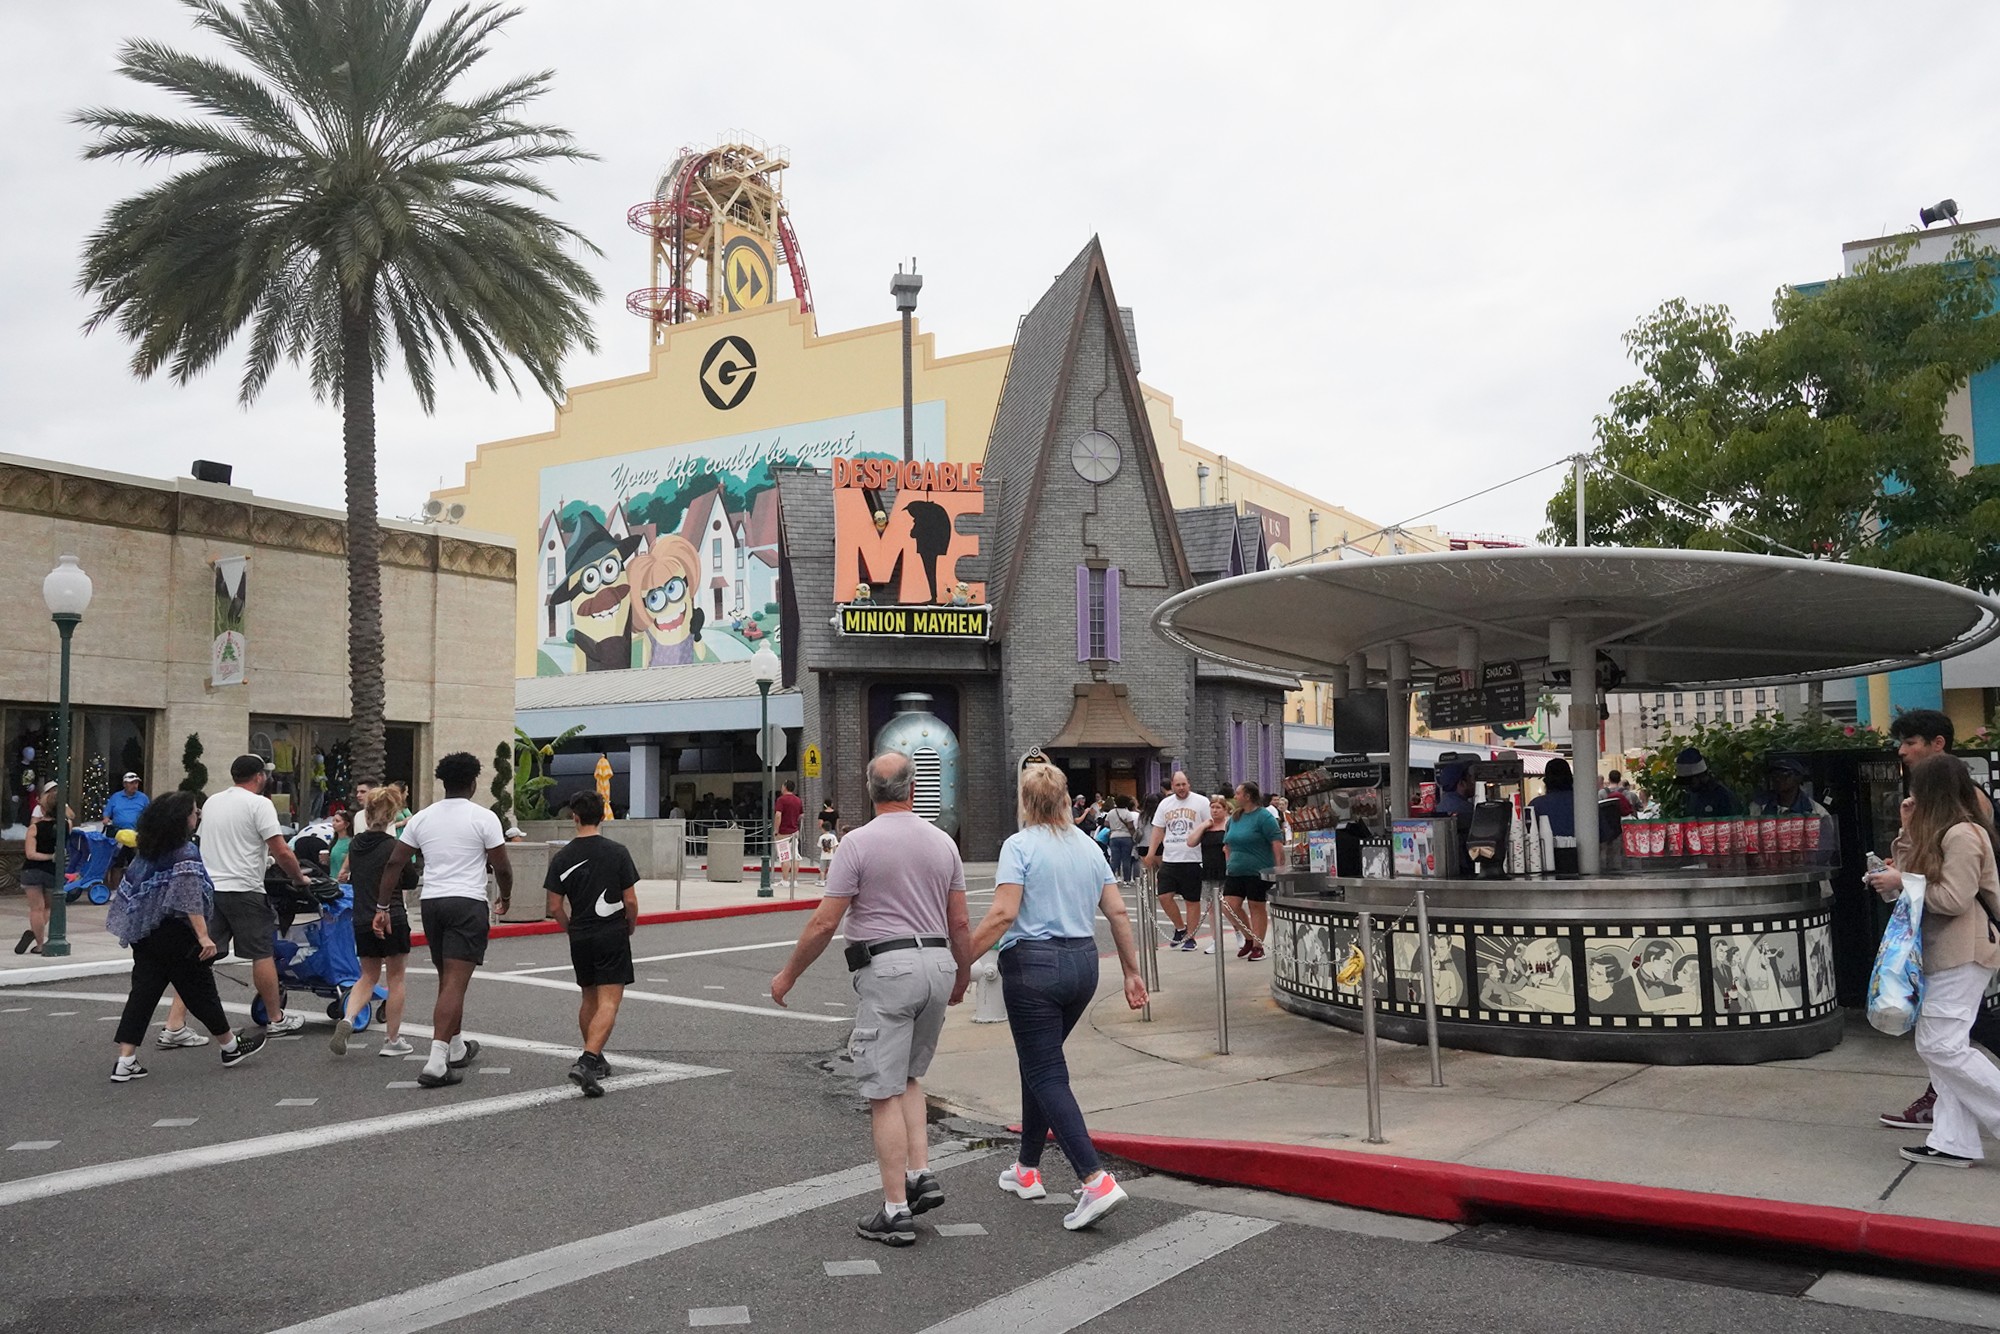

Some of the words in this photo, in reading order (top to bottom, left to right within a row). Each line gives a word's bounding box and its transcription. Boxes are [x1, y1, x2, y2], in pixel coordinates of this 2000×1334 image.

[611, 462, 659, 499] Your
[666, 453, 698, 489] life
[704, 443, 761, 475] could
[766, 436, 788, 465] be
[796, 430, 855, 468] great
[832, 457, 984, 491] DESPICABLE
[833, 488, 986, 604] ME
[845, 611, 906, 632] MINION
[913, 612, 983, 634] MAYHEM
[1439, 673, 1461, 686] DRINKS
[1486, 665, 1512, 679] SNACKS
[1333, 770, 1369, 779] Pretzels
[1164, 807, 1197, 822] BOSTON
